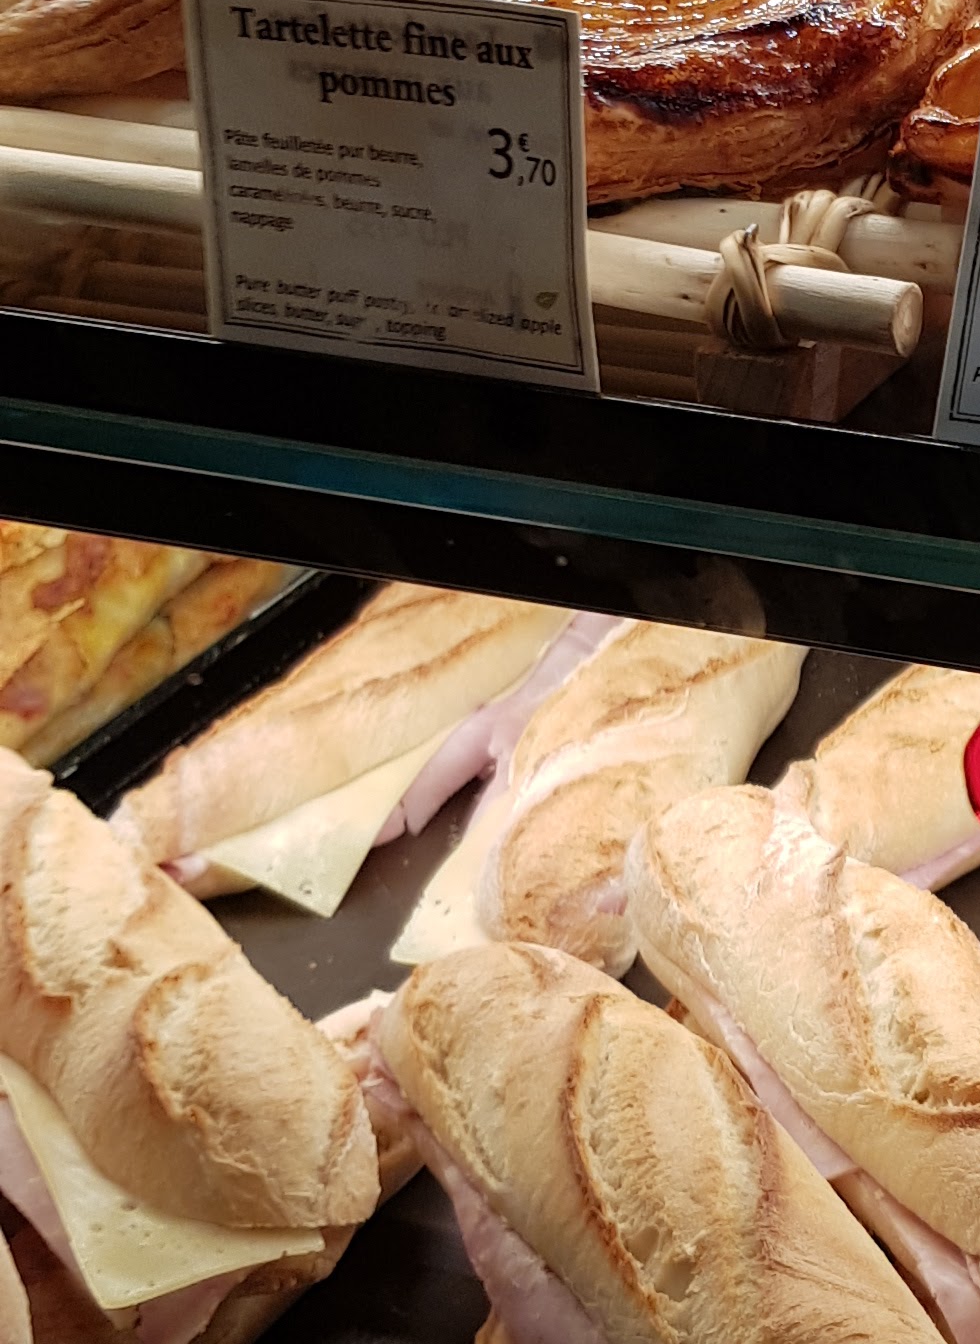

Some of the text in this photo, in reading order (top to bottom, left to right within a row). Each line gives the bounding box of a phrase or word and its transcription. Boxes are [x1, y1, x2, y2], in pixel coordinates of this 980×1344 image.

[230, 6, 534, 70] Tartelette fine aux
[319, 70, 456, 106] pommes
[386, 320, 446, 341] topping
[521, 315, 562, 336] apple
